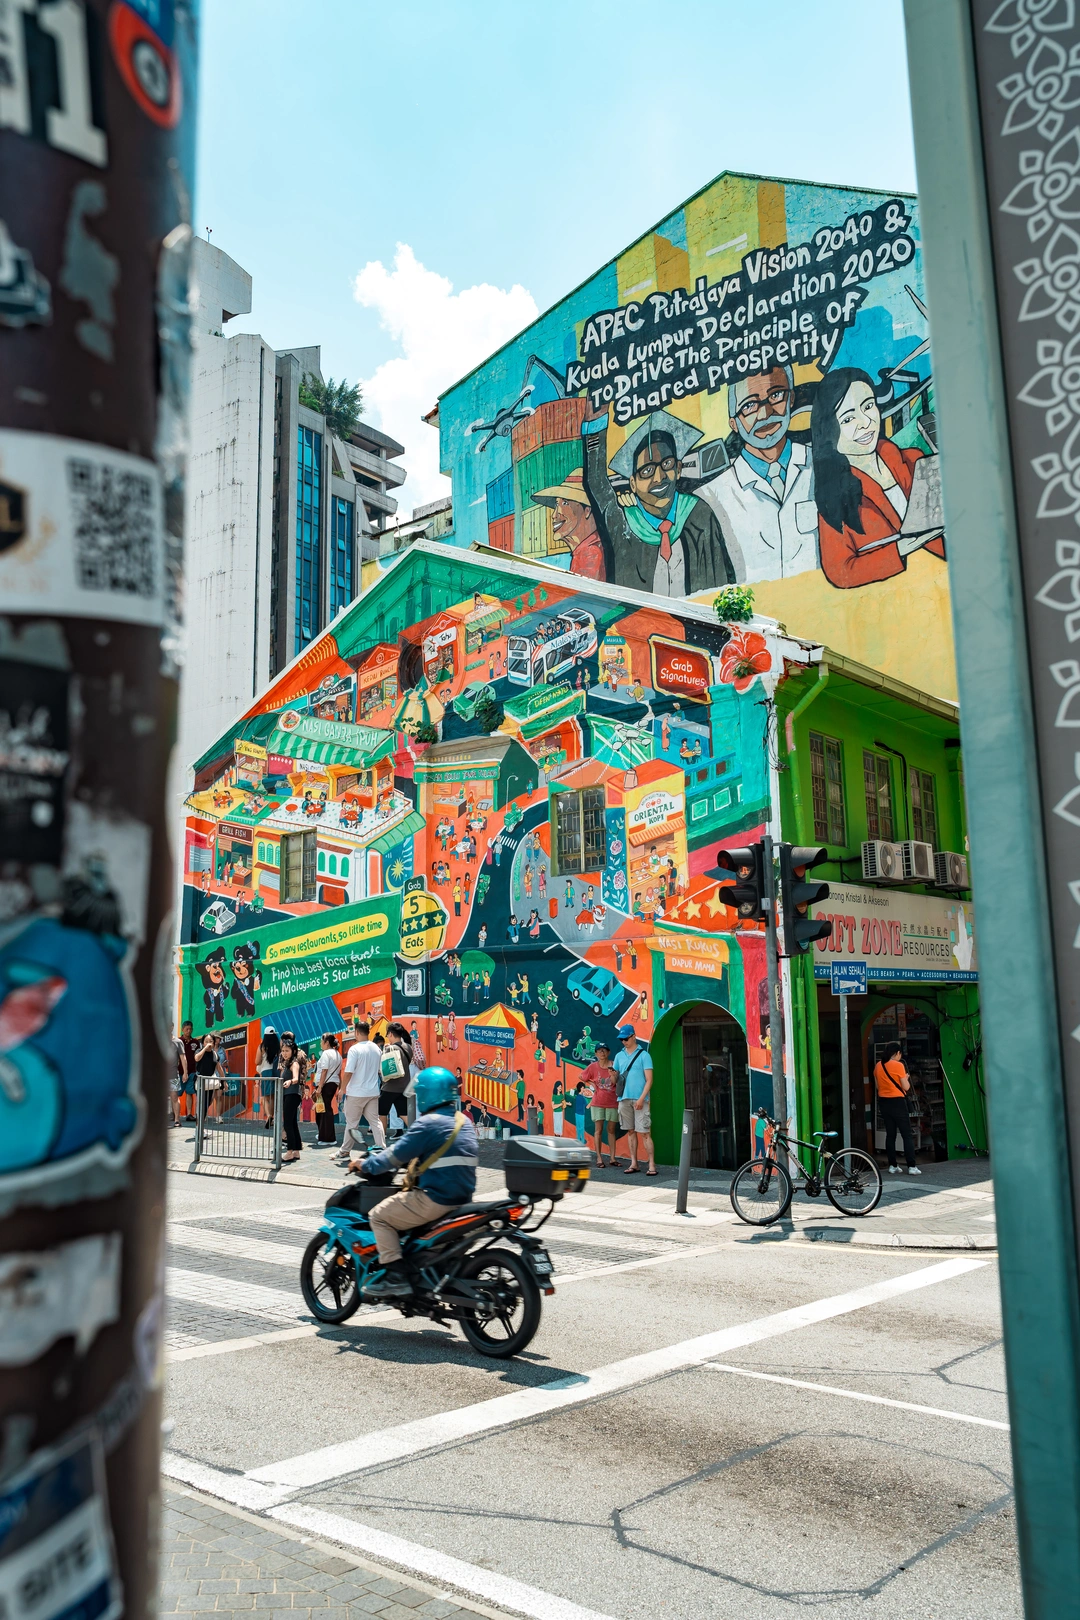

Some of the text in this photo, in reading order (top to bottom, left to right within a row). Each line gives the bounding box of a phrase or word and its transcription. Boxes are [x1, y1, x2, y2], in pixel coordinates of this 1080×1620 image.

[583, 203, 908, 353] APEC Putrajaya Vision 2040 &
[566, 238, 913, 392] Kuala Lumpur Declaration 2020
[614, 355, 675, 399] Drive
[675, 346, 711, 368] The
[715, 308, 815, 360] Principle
[615, 368, 700, 422] Shared
[670, 657, 693, 673] Grab
[660, 667, 707, 687] Signatures
[302, 719, 321, 735] NASI
[634, 801, 675, 822] ORIENTAL
[648, 813, 665, 825] KOPI
[221, 825, 247, 838] GRILL FISH
[407, 880, 421, 890] Grab
[410, 895, 419, 915] 5
[829, 891, 890, 907] orong Kristal & Aksesori
[269, 948, 279, 959] So
[279, 946, 296, 956] many
[348, 923, 365, 937] little
[366, 920, 382, 932] time
[405, 936, 424, 949] Eats
[861, 917, 903, 956] ZONE
[658, 936, 720, 958] NASI KUKUS
[903, 941, 950, 957] RESOURCES
[271, 966, 291, 982] Find
[292, 963, 305, 976] the
[305, 961, 325, 977] best
[671, 957, 693, 968] DAPUR
[833, 965, 866, 976] JALAN SEHALA
[261, 963, 371, 1001] with Malaysia's 5 Star Eats
